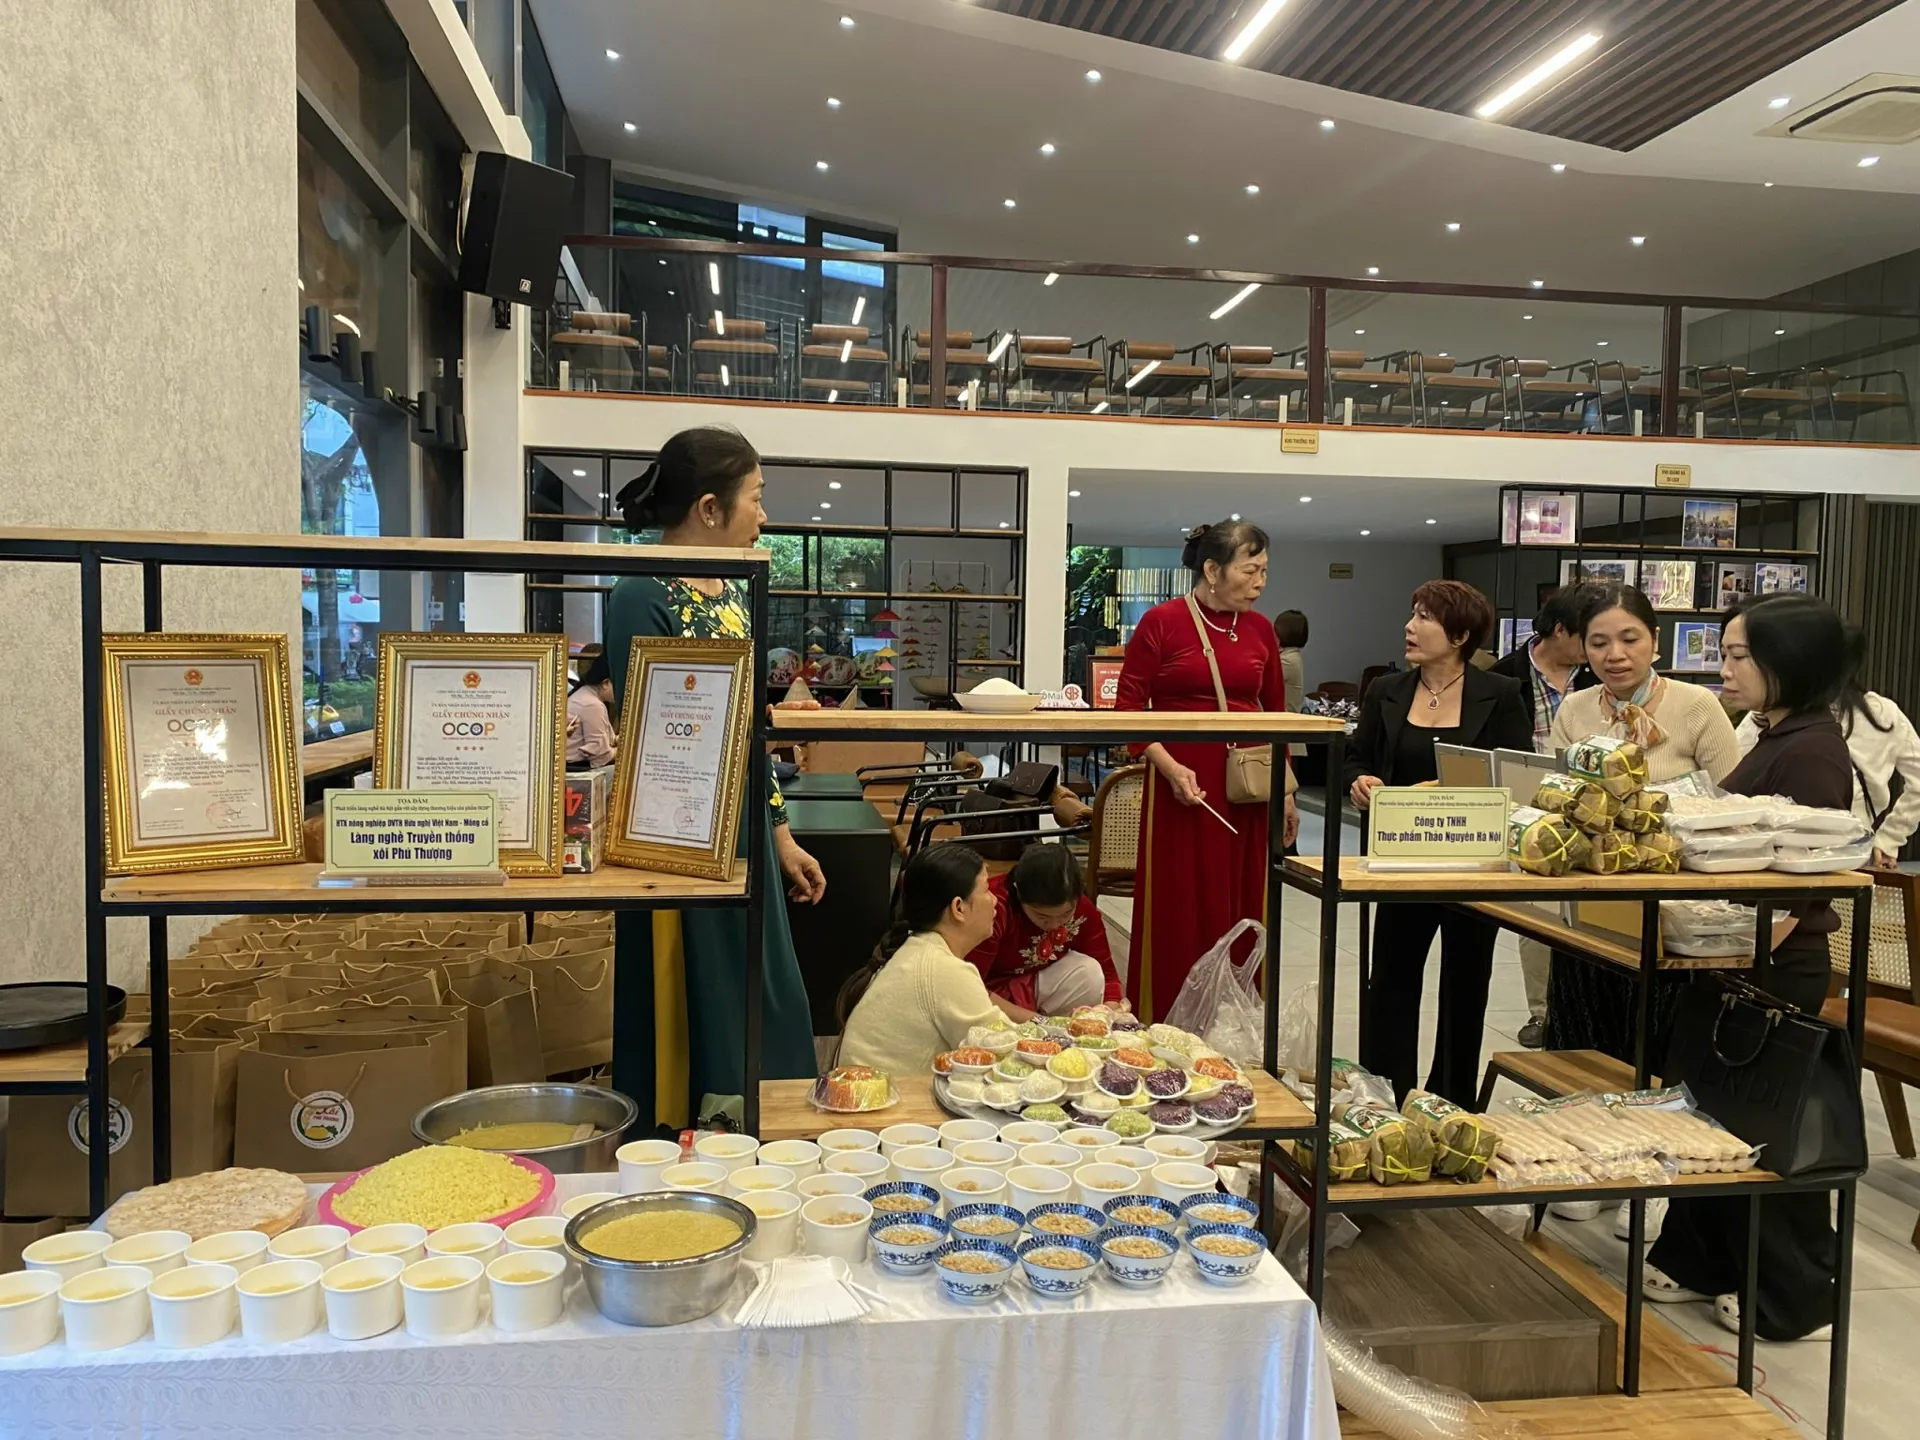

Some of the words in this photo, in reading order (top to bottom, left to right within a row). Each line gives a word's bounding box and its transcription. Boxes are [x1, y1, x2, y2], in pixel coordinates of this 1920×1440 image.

[432, 708, 453, 718] GIẤY
[454, 709, 484, 719] CHỨNG
[486, 710, 510, 719] NHẬN
[442, 722, 496, 736] OCOP
[665, 722, 701, 737] OCOP
[445, 819, 459, 827] Nam
[1414, 816, 1435, 828] Công
[1437, 817, 1444, 828] ty
[1446, 816, 1467, 827] TNHH
[351, 831, 375, 845] Làng
[378, 830, 404, 845] nghề
[407, 830, 442, 845] Truyền
[445, 829, 475, 844] thống
[1377, 831, 1397, 844] Thực
[1399, 829, 1422, 842] phẩm
[1424, 829, 1443, 842] Thảo
[1445, 831, 1475, 843] Nguyên
[1476, 831, 1487, 842] Hà
[1489, 831, 1501, 844] Nội
[373, 847, 389, 860] xôi
[392, 847, 411, 860] Phú
[414, 847, 452, 862] Thượng
